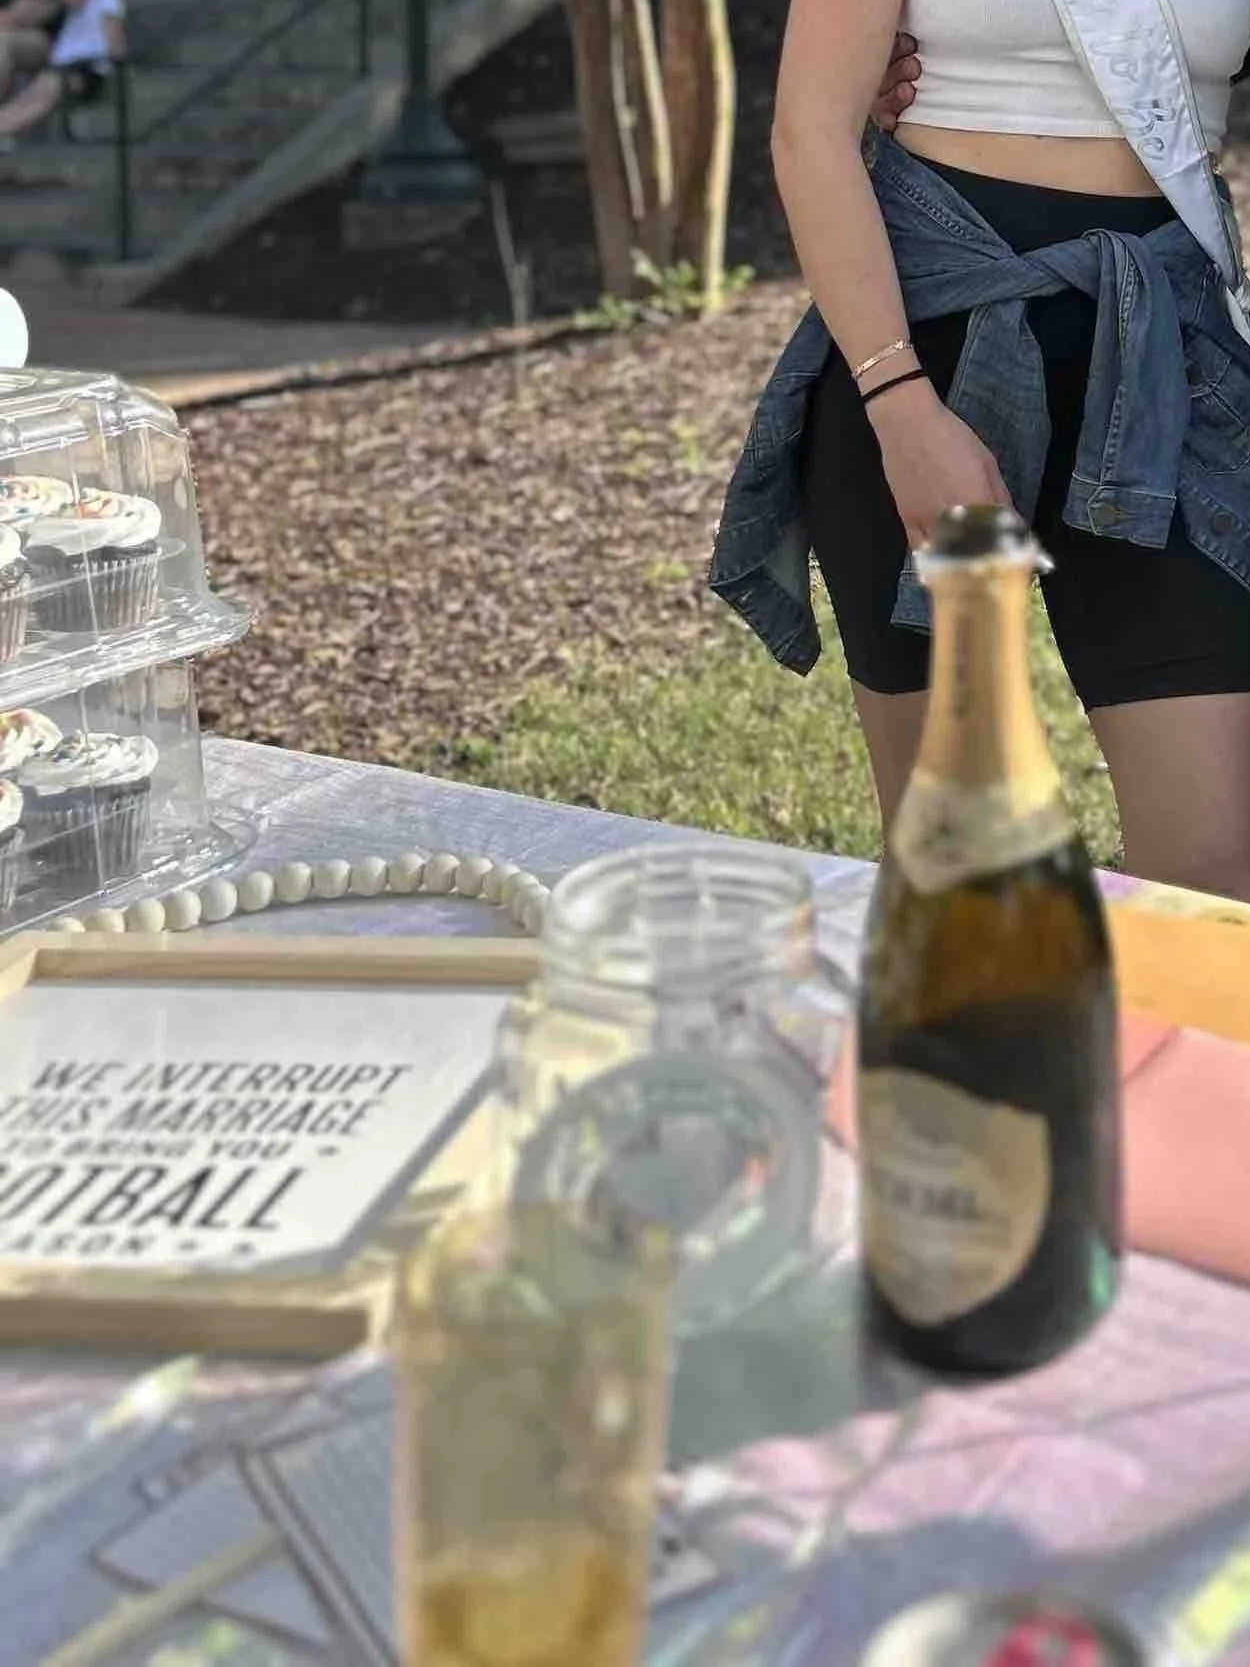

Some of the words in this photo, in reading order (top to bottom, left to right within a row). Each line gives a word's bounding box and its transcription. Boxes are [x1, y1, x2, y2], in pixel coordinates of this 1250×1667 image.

[34, 1061, 124, 1091] WE
[121, 1061, 413, 1094] INTERRUPT
[105, 1098, 383, 1134] MARRIAGE
[0, 1162, 305, 1228] OTBALL
